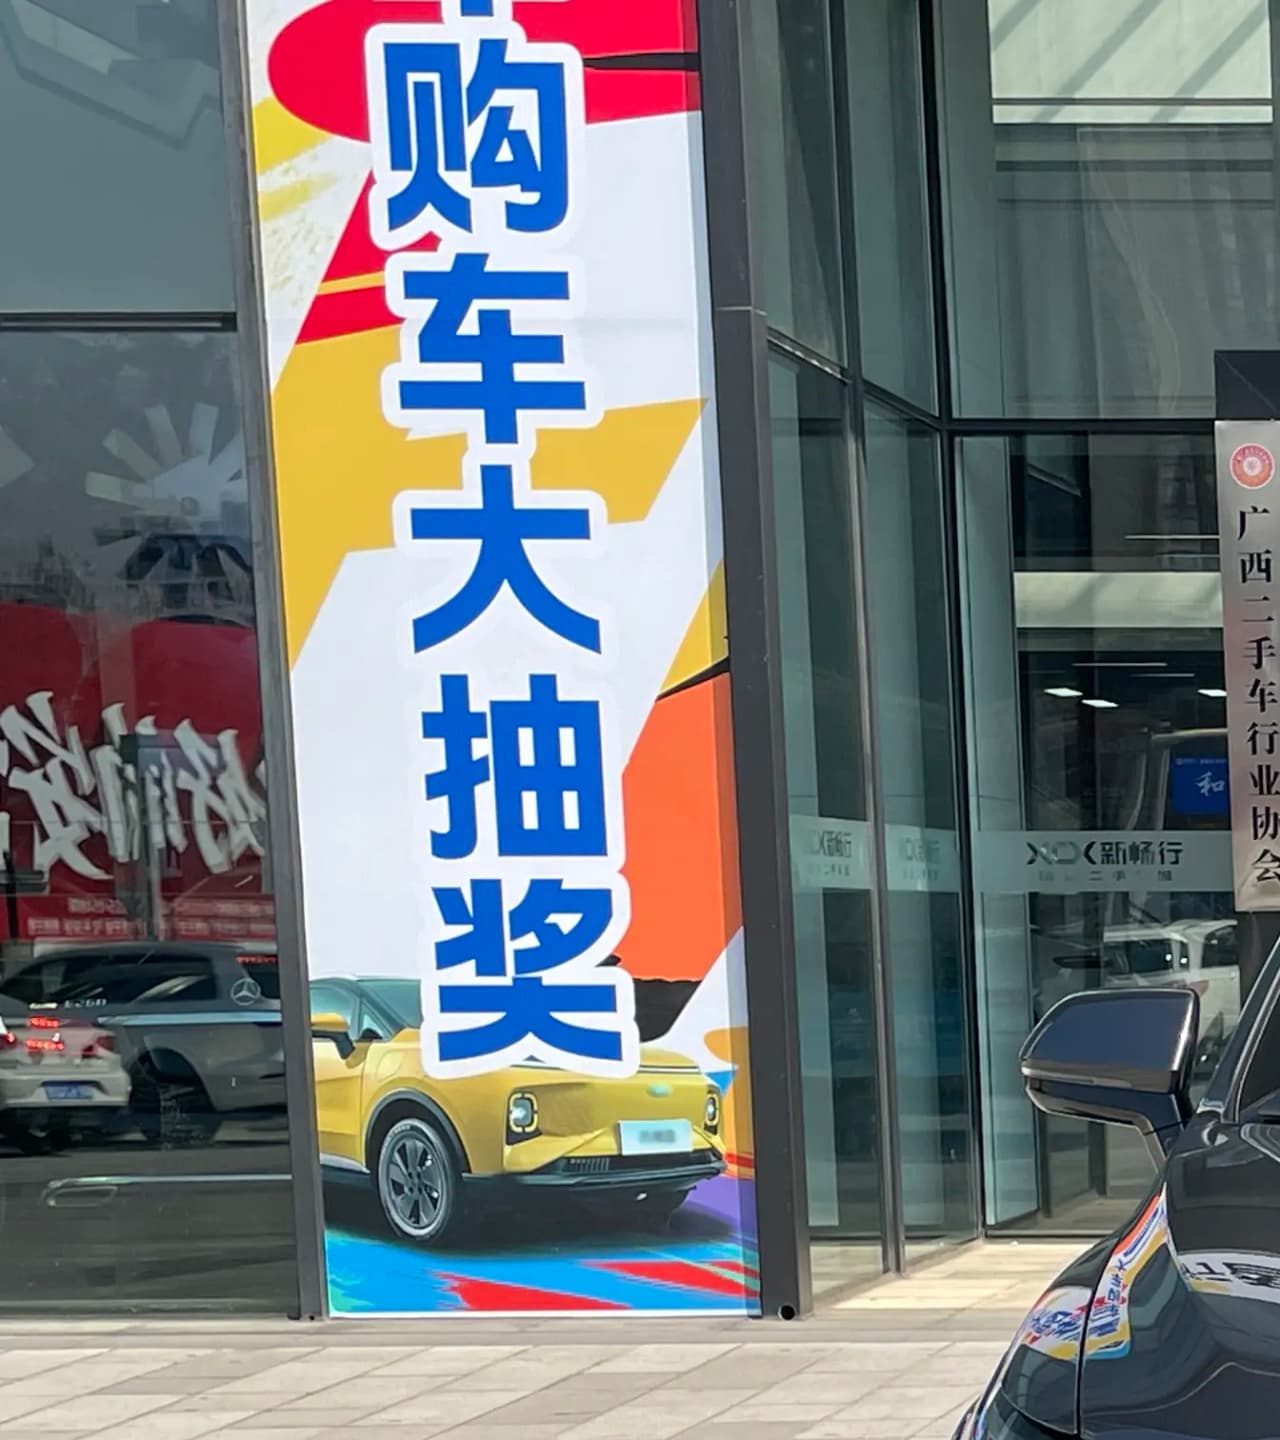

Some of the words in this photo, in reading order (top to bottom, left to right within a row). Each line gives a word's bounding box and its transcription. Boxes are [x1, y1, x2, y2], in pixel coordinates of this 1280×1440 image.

[384, 0, 624, 1063] 购车大抽奖
